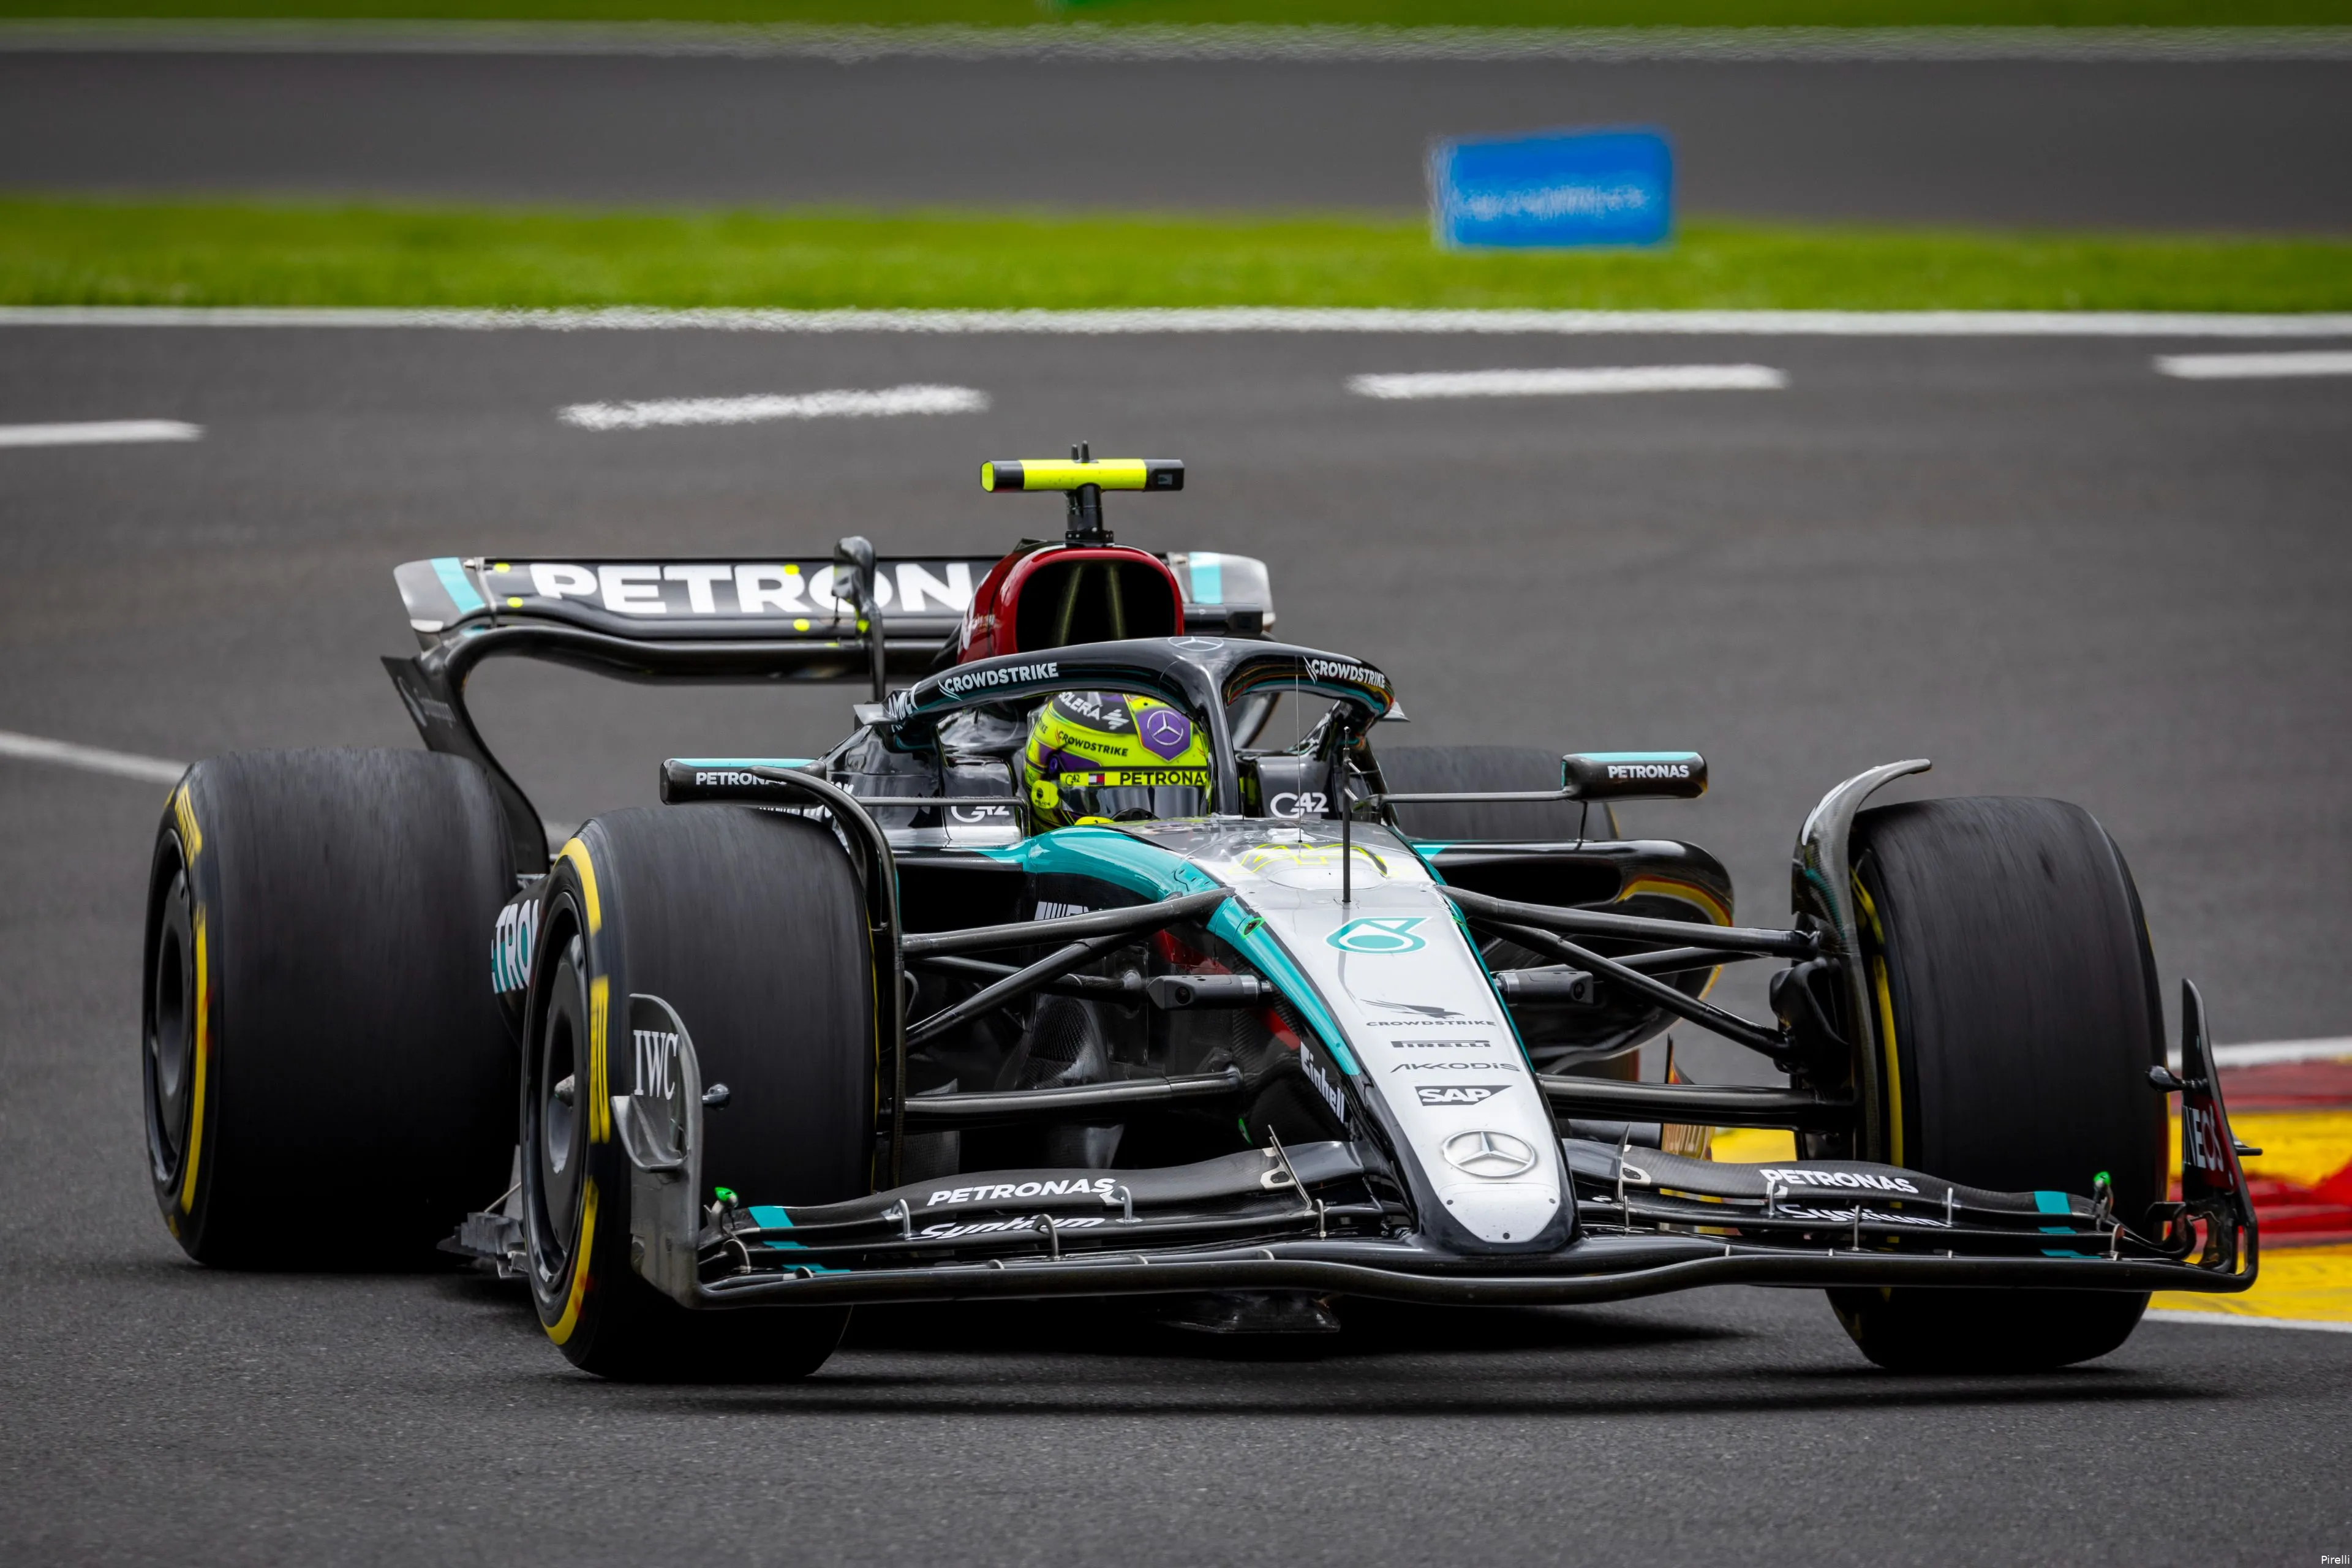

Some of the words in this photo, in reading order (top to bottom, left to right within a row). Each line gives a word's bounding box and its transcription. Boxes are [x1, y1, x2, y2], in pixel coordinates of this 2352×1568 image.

[944, 662, 1059, 693] CROWDSTRIKE
[1311, 659, 1385, 689] CROWDSTRIKE
[1058, 730, 1129, 757] CROWDSTRIKE
[696, 772, 788, 785] PETRON
[1607, 765, 1690, 778] PETRONAS
[1270, 792, 1329, 819] G42
[1390, 1039, 1491, 1048] PIRELLI
[633, 1030, 679, 1100] IWC
[1300, 1041, 1345, 1124] Einhell
[1418, 1088, 1492, 1102] SAP
[927, 1178, 1117, 1205] PETRONAS
[1759, 1169, 1919, 1193] PETRONAS
